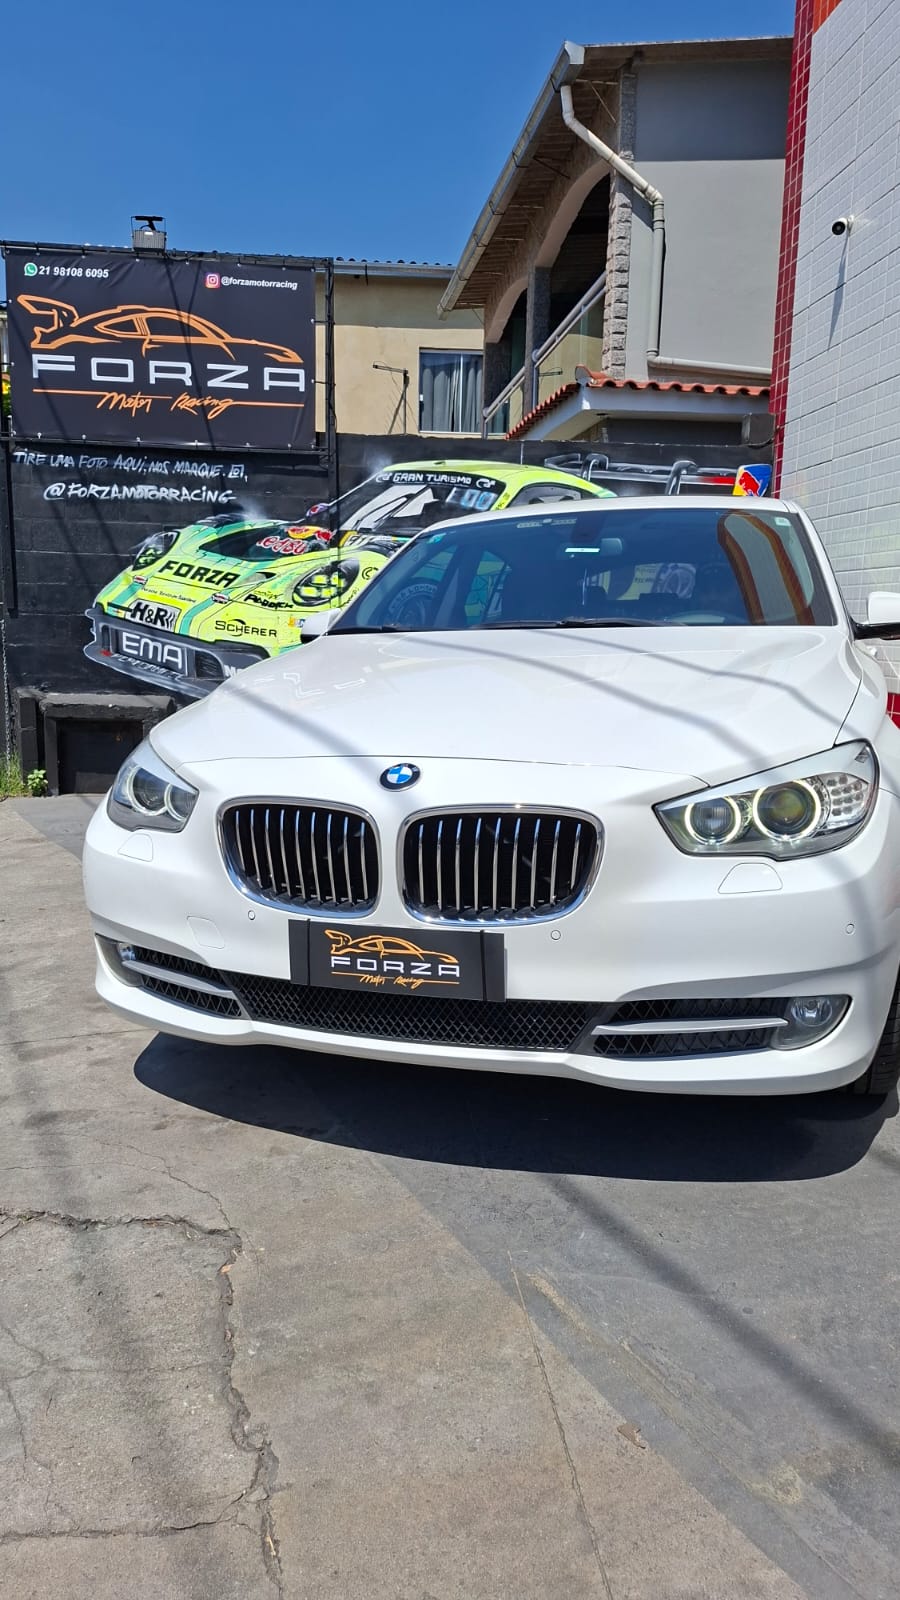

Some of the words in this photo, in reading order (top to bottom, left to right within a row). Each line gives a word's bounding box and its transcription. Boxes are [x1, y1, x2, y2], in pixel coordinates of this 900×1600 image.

[39, 265, 51, 275] 21
[53, 267, 83, 277] 98108
[85, 268, 110, 278] 6095
[221, 276, 299, 290] @forzamotorracing
[32, 354, 306, 392] FORZA
[96, 391, 153, 417] Motor
[169, 391, 234, 420] Racing
[50, 454, 75, 467] UMA
[79, 454, 108, 469] FOTO
[148, 460, 171, 475] NOS
[392, 472, 424, 483] GRAN
[426, 473, 473, 485] TURISMO
[43, 482, 237, 504] @FORZAMOTORRACING
[158, 560, 241, 588] FORZA
[130, 602, 168, 627] H&R
[214, 619, 278, 638] SCHERER
[122, 632, 183, 670] EMA
[331, 956, 460, 977] FORZA
